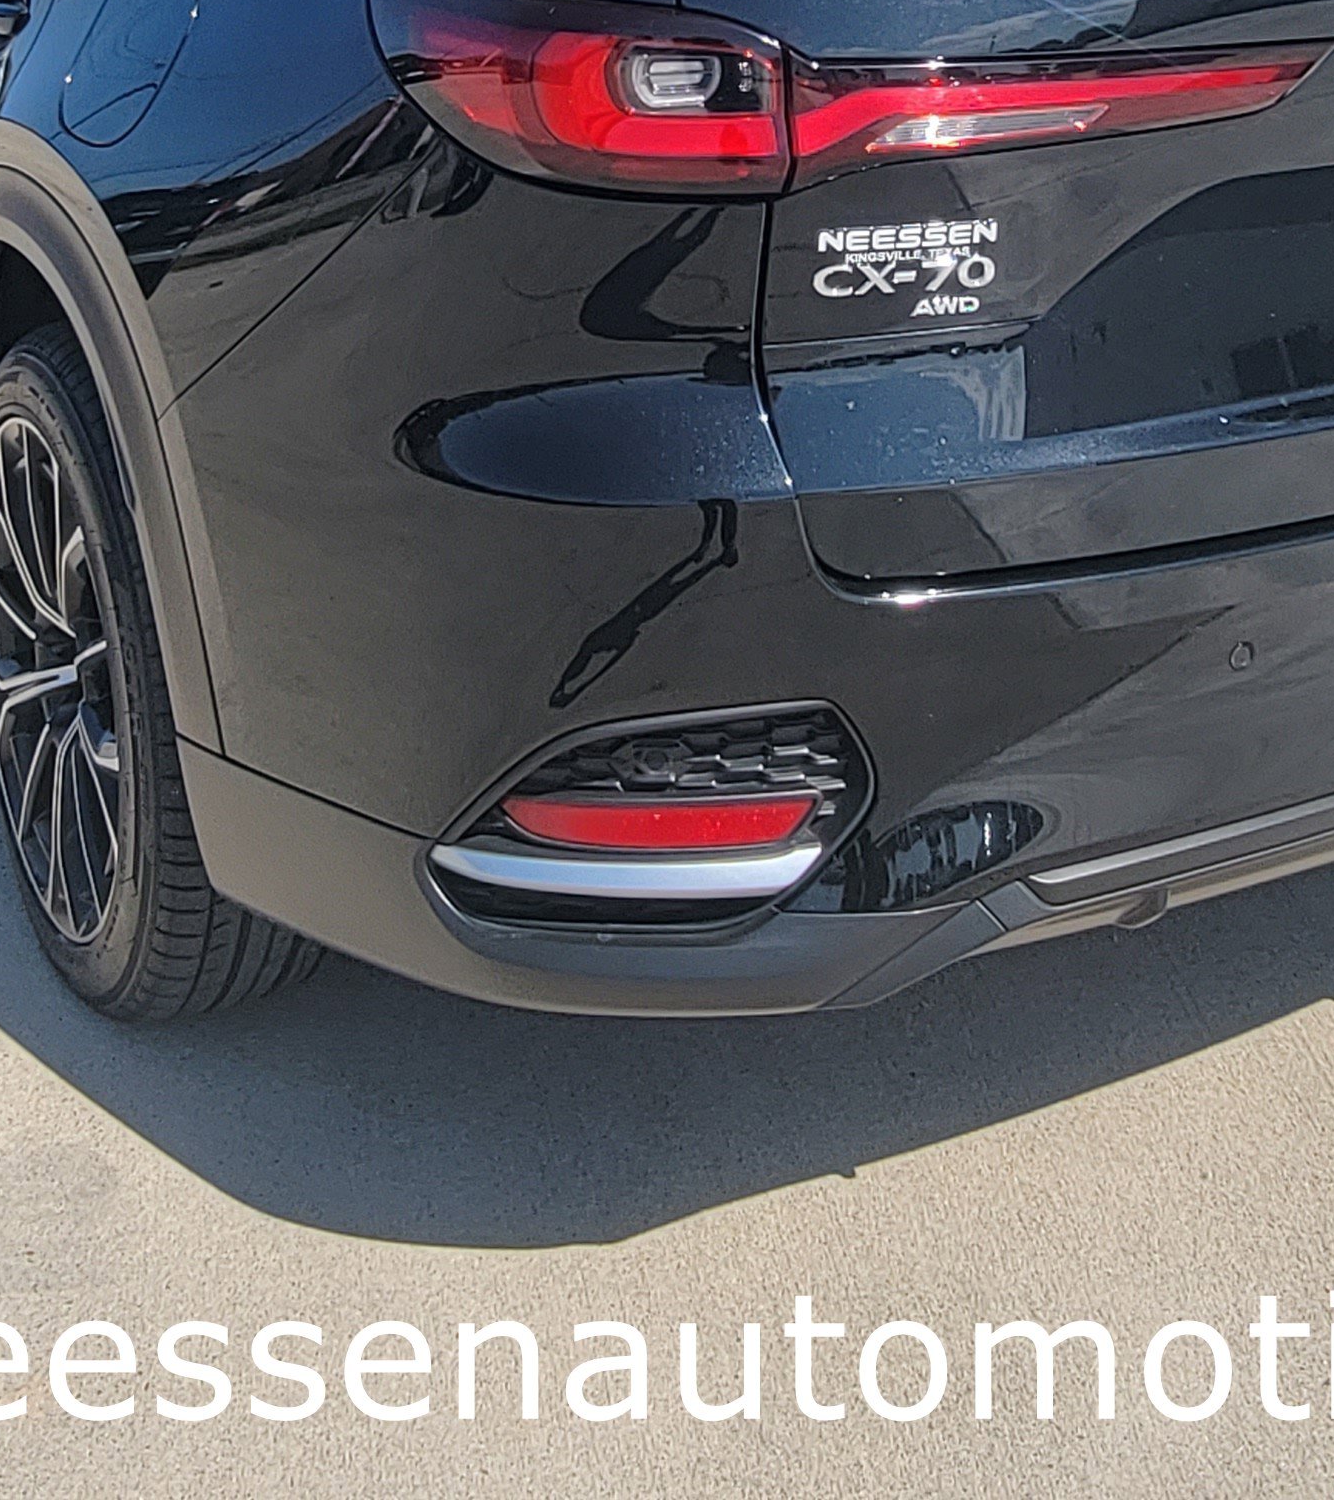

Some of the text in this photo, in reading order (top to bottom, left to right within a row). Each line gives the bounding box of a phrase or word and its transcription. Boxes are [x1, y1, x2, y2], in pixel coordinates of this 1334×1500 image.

[817, 219, 998, 252] NEESSEN
[812, 253, 996, 297] CX-70
[909, 295, 980, 317] AWD
